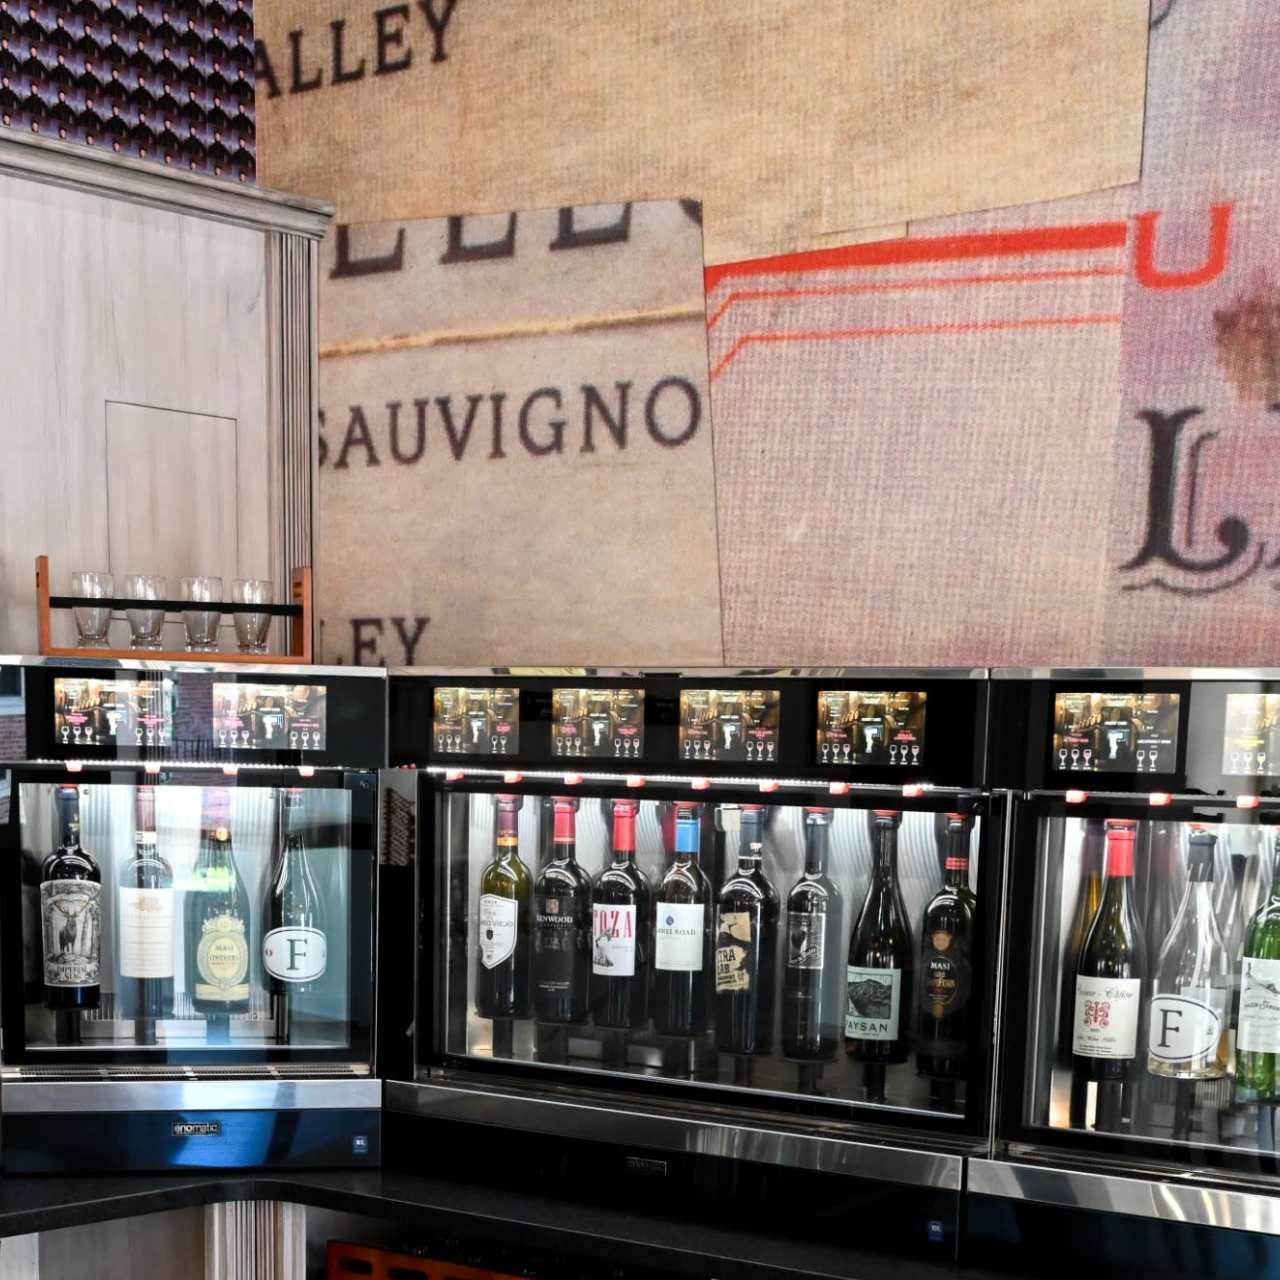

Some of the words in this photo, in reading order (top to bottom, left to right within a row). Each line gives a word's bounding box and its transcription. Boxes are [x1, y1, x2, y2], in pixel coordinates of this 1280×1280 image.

[254, 0, 457, 98] ALLEY
[1133, 204, 1233, 290] U
[320, 616, 431, 667] EY
[285, 938, 308, 971] F
[930, 962, 951, 970] MASI
[847, 1022, 888, 1033] AYSAN
[1159, 1008, 1182, 1048] F
[174, 1122, 218, 1135] enomatic
